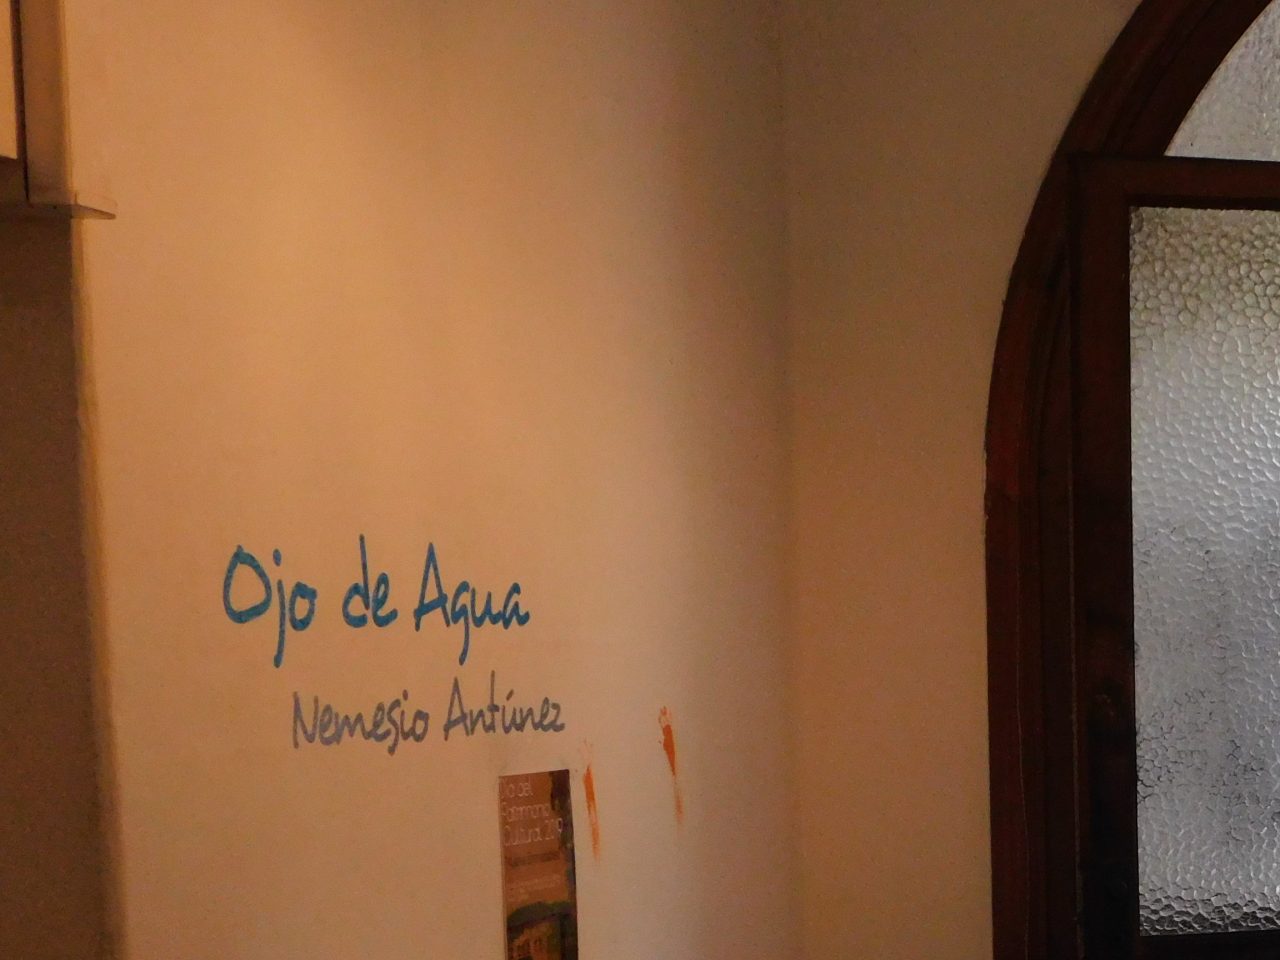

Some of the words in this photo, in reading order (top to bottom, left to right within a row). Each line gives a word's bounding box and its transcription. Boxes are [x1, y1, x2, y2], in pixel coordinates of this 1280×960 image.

[222, 544, 318, 669] Ojo
[341, 534, 399, 629] de
[413, 541, 531, 666] Agua
[292, 689, 430, 757] Nemesio
[443, 669, 566, 742] Antúnez
